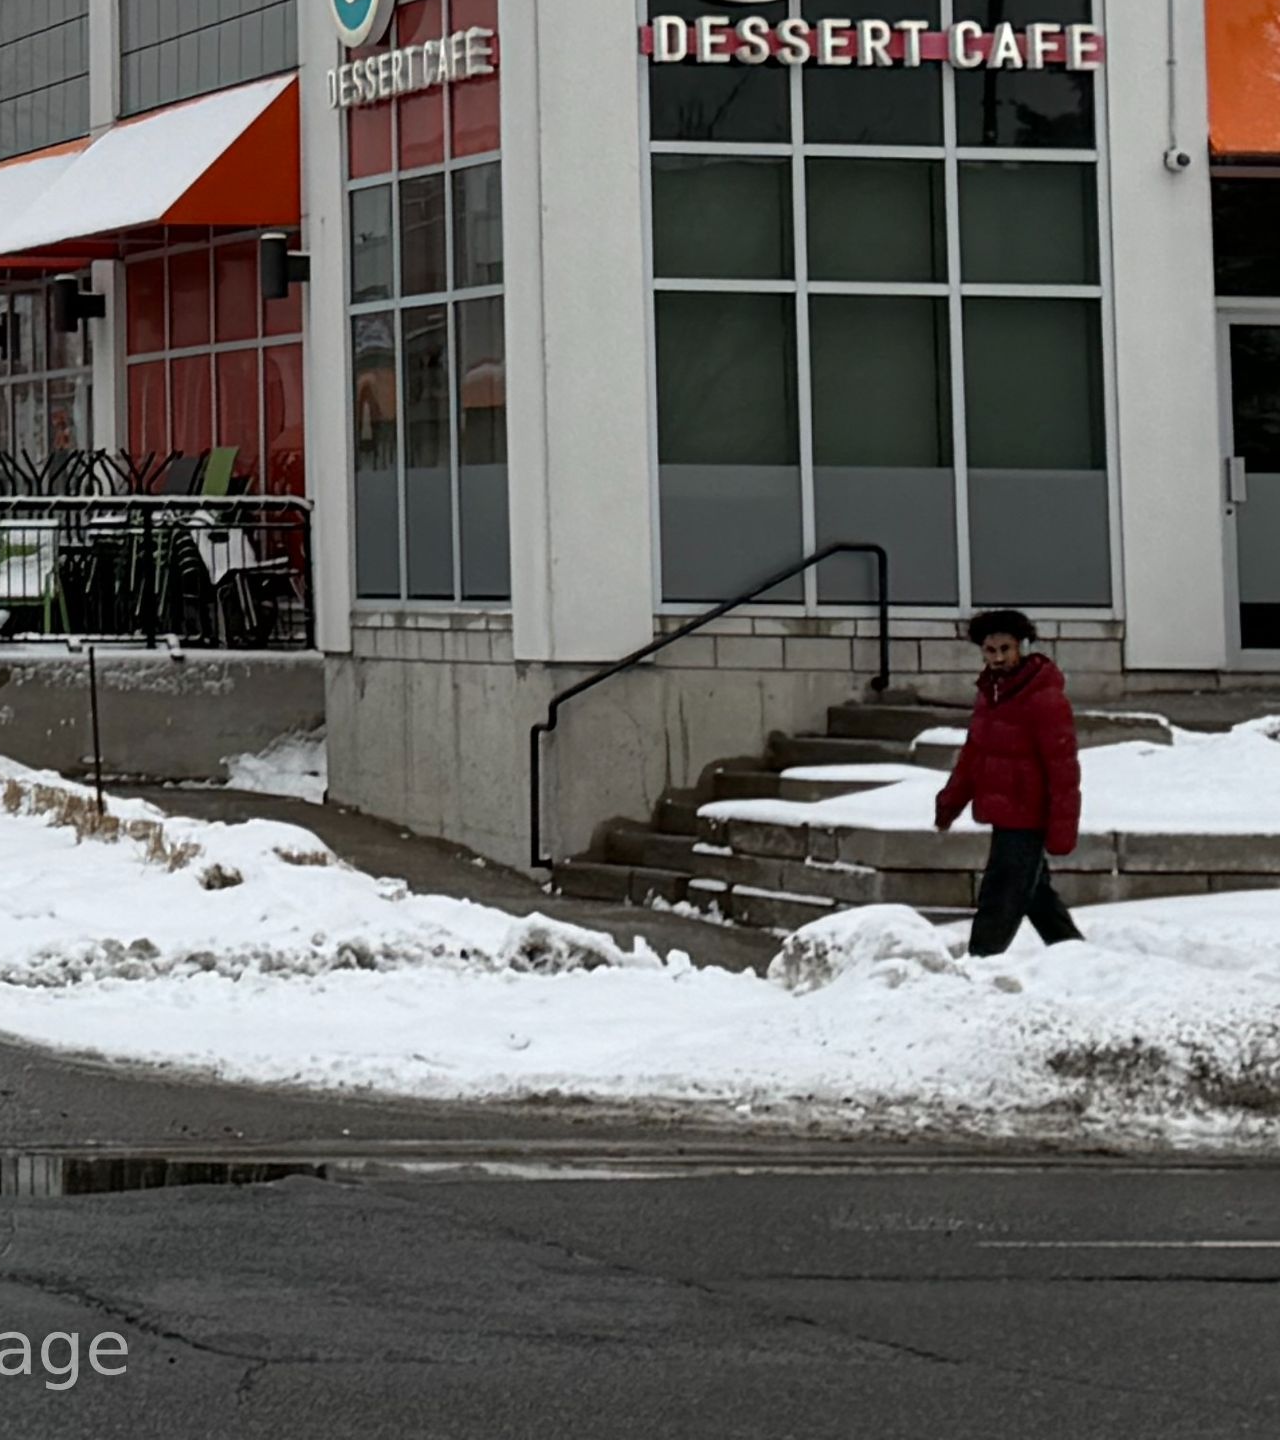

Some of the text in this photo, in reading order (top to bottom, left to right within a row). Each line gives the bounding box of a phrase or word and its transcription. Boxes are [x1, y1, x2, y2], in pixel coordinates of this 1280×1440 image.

[327, 27, 494, 109] DESSERT CAFE
[652, 15, 1101, 71] DESSERT CAFE
